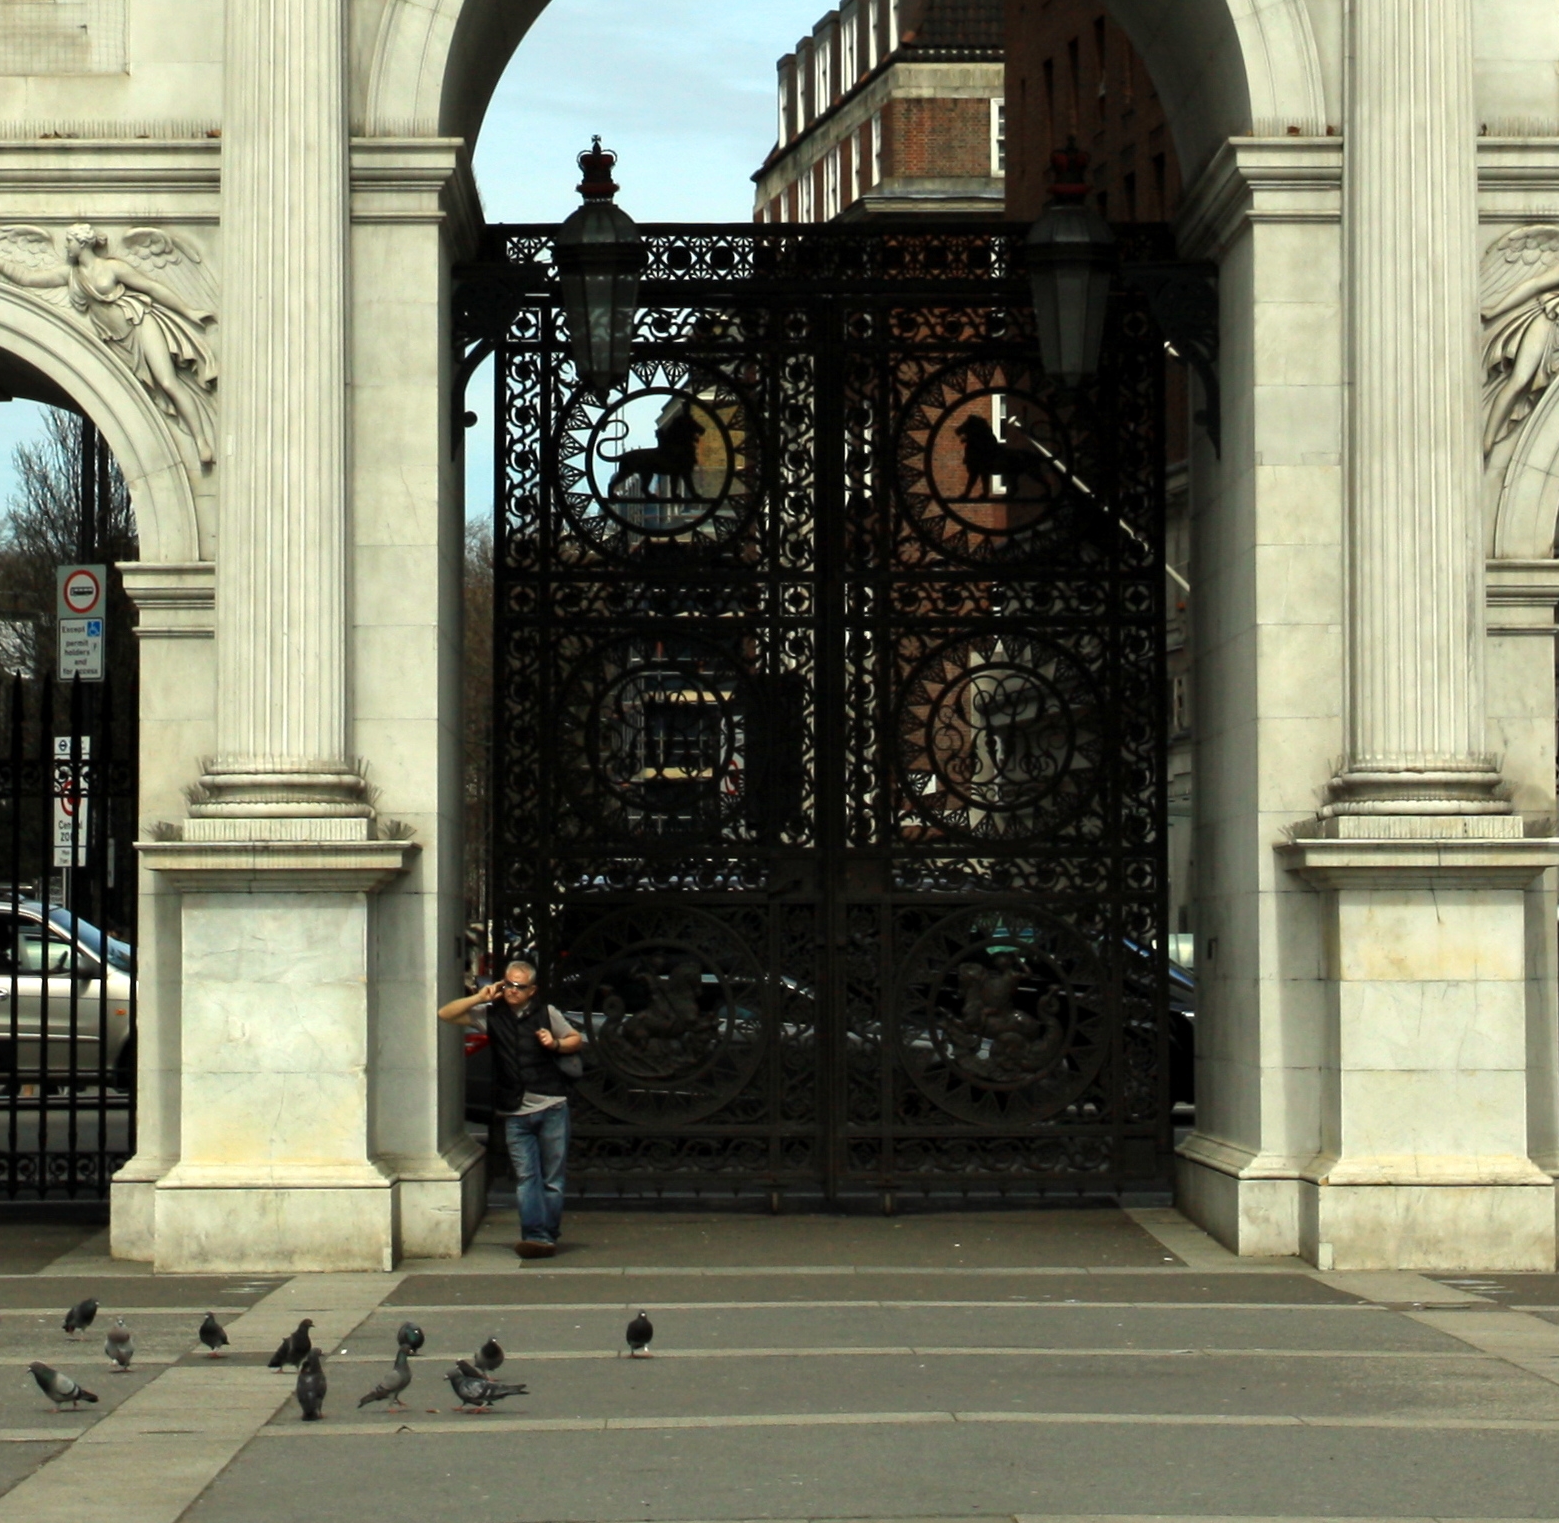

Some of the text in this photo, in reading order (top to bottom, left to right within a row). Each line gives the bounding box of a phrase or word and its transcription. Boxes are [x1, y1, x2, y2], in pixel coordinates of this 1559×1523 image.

[62, 625, 85, 634] Except
[65, 638, 89, 647] permit
[64, 648, 90, 656] holders
[74, 658, 87, 666] and
[58, 819, 83, 829] Cenal
